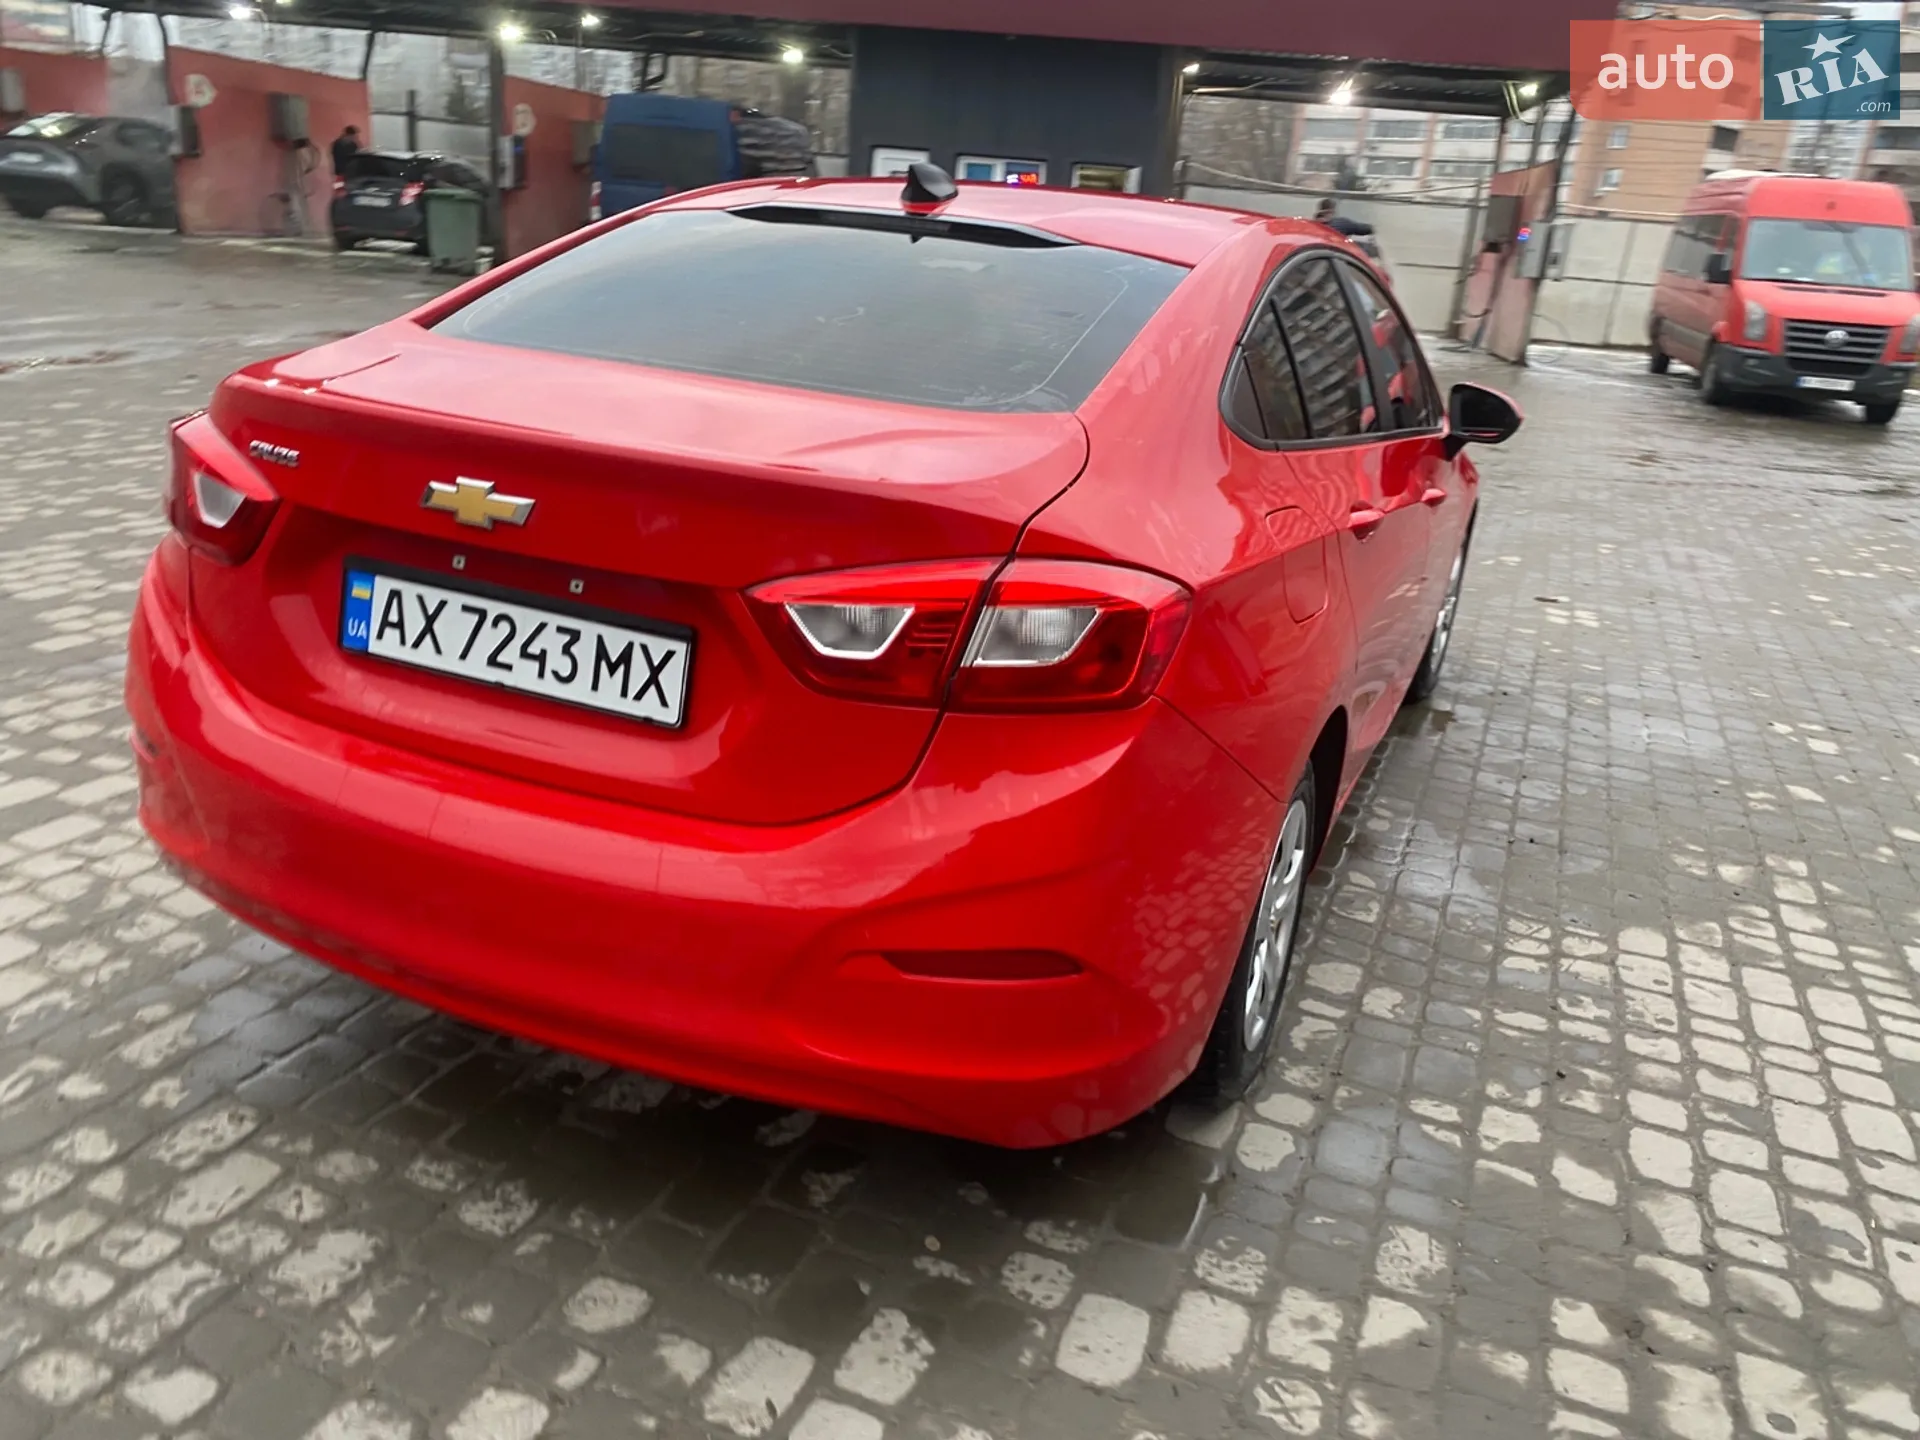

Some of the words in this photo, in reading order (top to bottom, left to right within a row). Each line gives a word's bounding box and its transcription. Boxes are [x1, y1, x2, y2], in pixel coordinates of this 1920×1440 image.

[348, 617, 368, 640] UA
[375, 588, 449, 655] AX
[458, 603, 582, 684] 7243
[590, 633, 677, 708] MX
